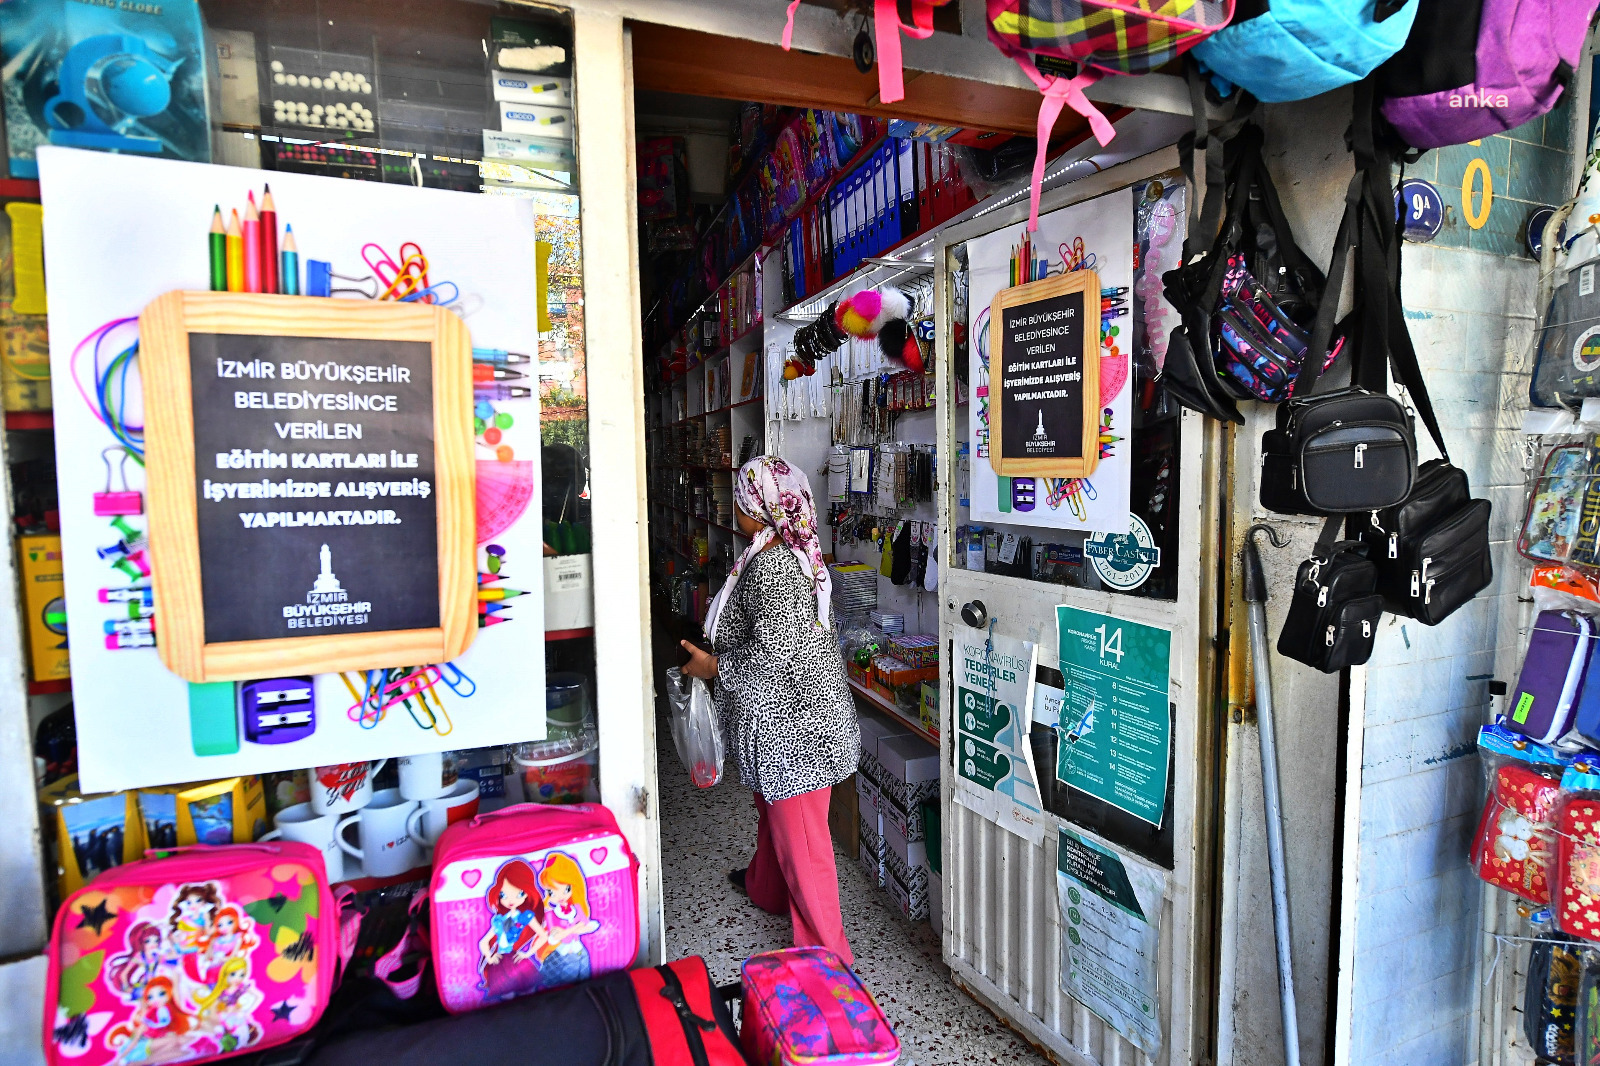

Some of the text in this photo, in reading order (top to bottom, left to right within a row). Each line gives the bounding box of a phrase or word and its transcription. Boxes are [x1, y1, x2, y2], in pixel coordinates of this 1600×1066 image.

[1028, 308, 1075, 325] BÜYÜKŞEHİR
[1014, 325, 1069, 343] BELEDİYESİNCE
[1026, 343, 1056, 355] VERİLEN
[217, 358, 411, 385] İZMİR BÜYÜKŞEHİR
[1008, 355, 1077, 373] EĞİTİM KARTLARI İLE
[1004, 370, 1081, 389] İŞYERİMİZDE ALIŞVERİŞ
[234, 390, 398, 412] BELEDİYESİNCE
[274, 420, 362, 440] VERİLEN
[216, 449, 419, 469] EĞİTİM KARTLARI İLE
[203, 477, 431, 502] İŞYERİMİZDE ALIŞVERİŞ
[239, 510, 402, 528] YAPILMAKTADIR.
[1094, 623, 1124, 663] 14
[965, 657, 1016, 684] TEDBRLER
